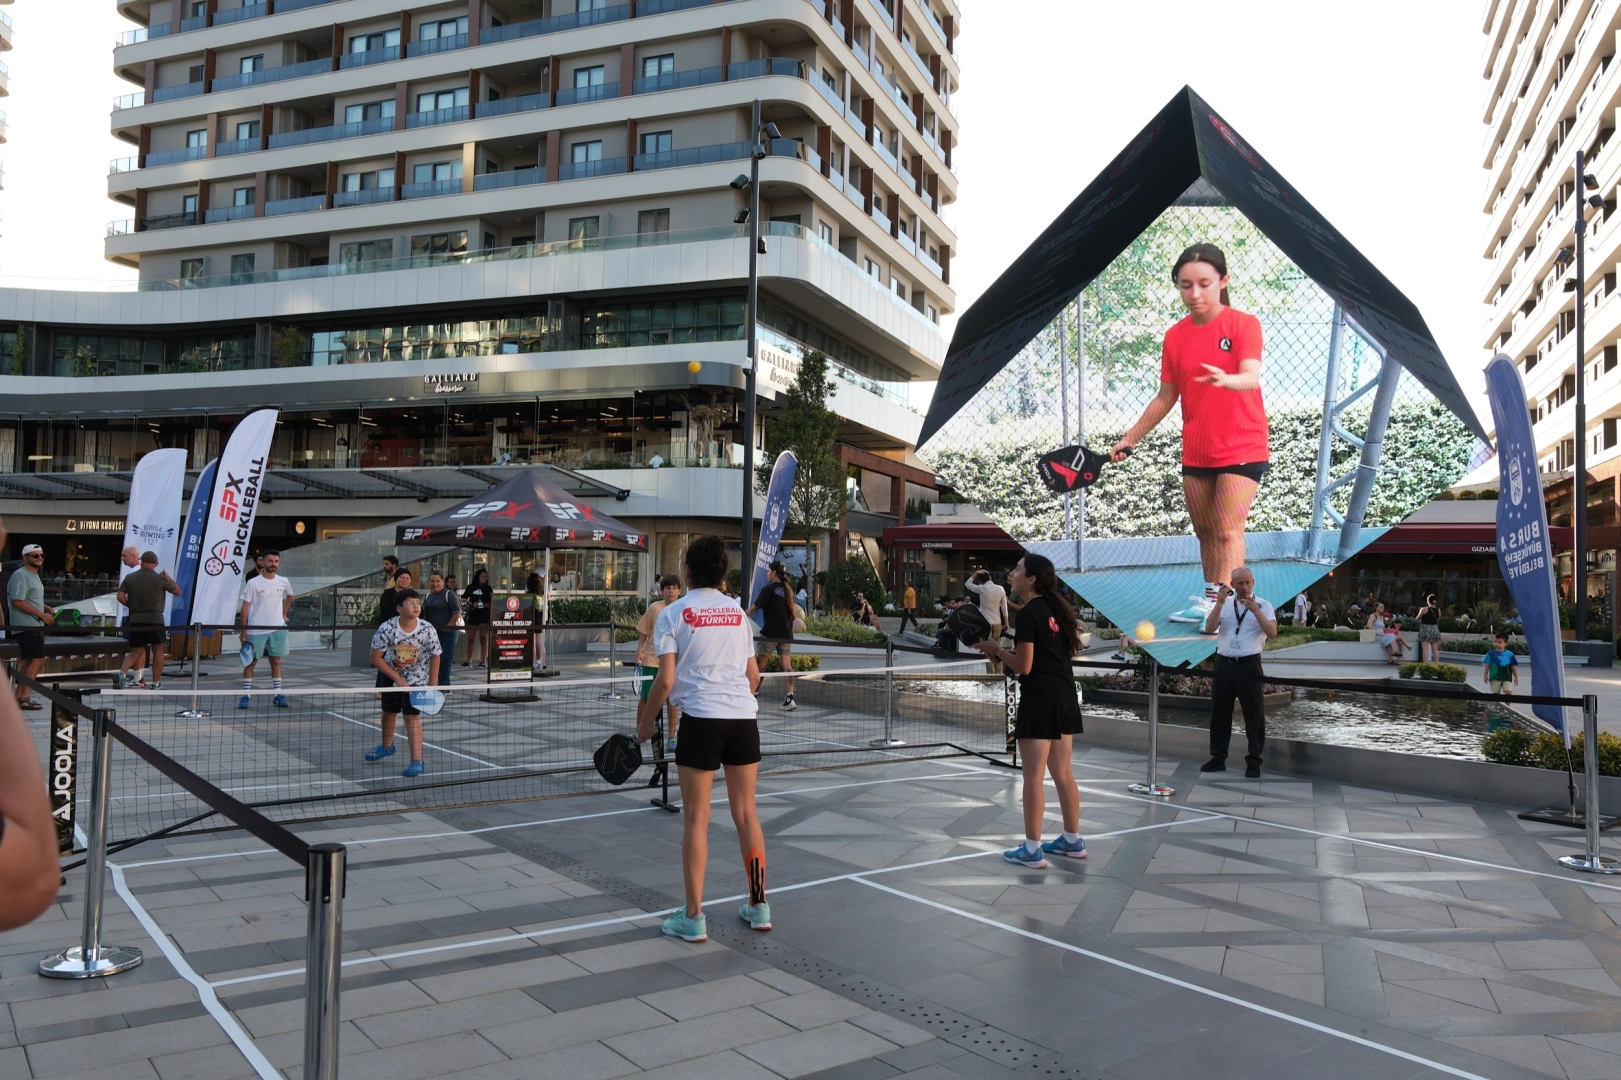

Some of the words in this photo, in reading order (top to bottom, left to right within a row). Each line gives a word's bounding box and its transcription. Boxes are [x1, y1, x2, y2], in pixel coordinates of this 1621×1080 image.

[424, 373, 476, 383] GALLIARD
[219, 471, 245, 523] SPX
[233, 457, 264, 556] PICKLEBALL
[449, 501, 532, 519] SPX
[545, 502, 601, 521] SPX
[140, 531, 165, 539] ROWING
[143, 524, 162, 533] BURSA
[402, 528, 433, 540] SPX
[456, 525, 486, 538] SPX
[511, 527, 541, 540] SPX
[556, 528, 577, 541] SPX
[592, 529, 612, 542] SPX
[626, 534, 645, 546] SPX
[503, 612, 521, 620] SPX
[701, 614, 739, 625] TÜRKİYE
[1006, 687, 1016, 735] JOOLA
[55, 724, 74, 801] JOOLA
